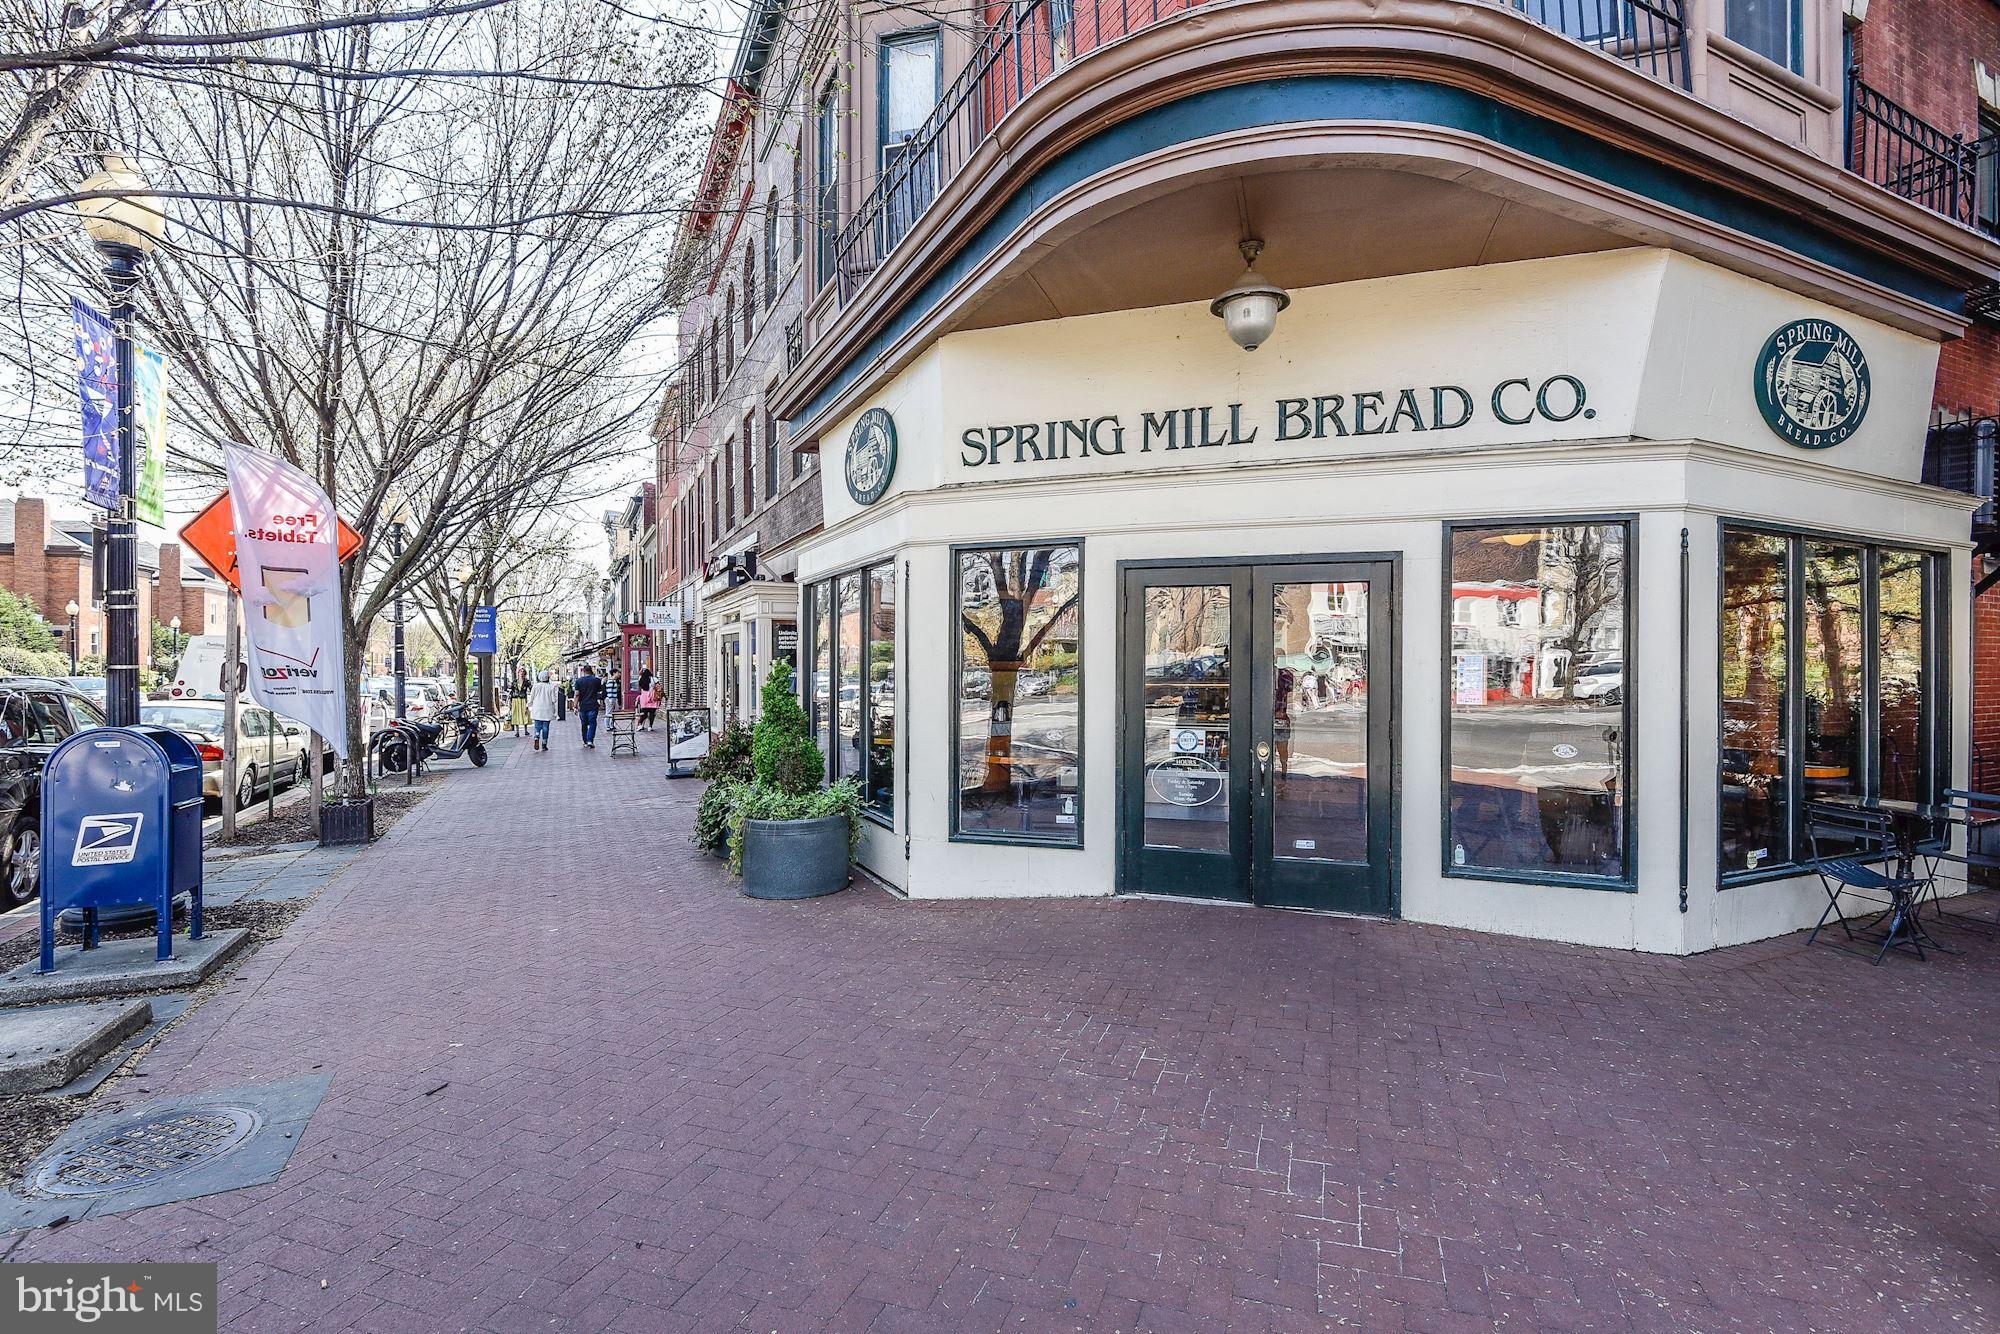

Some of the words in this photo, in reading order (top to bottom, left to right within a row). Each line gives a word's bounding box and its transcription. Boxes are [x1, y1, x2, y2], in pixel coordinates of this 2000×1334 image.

[1776, 322, 1833, 355] SPRING
[1837, 330, 1865, 377] MILL
[848, 413, 871, 456] SPRING
[871, 410, 887, 433] MILL
[961, 414, 1126, 467] SPRING
[1140, 403, 1259, 453] MILL
[1275, 385, 1474, 442] BREAD
[1491, 374, 1597, 425] CO.
[1777, 413, 1821, 446] BREAD
